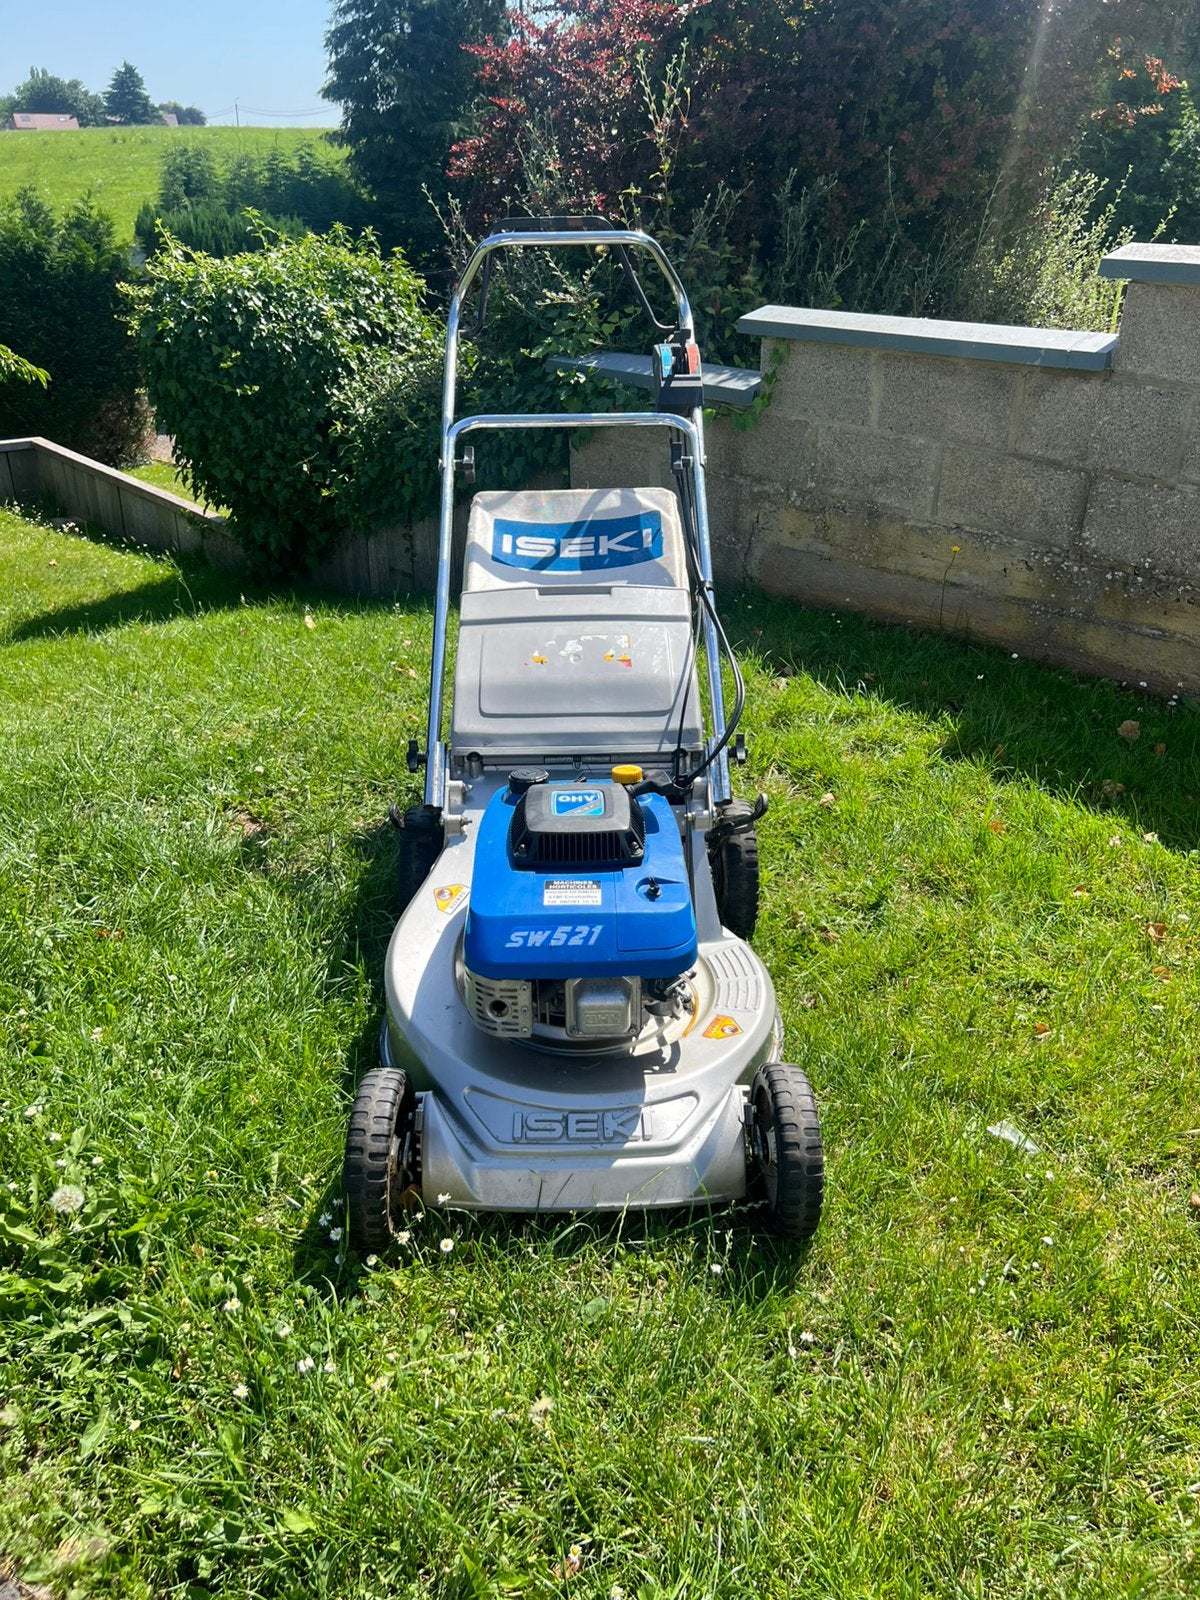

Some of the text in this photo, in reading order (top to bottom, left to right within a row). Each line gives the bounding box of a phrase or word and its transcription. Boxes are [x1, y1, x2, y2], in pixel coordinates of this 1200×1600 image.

[502, 528, 653, 558] ISEKI
[558, 795, 595, 803] OHV
[505, 925, 603, 947] SW521
[512, 1112, 653, 1142] ISEKI
